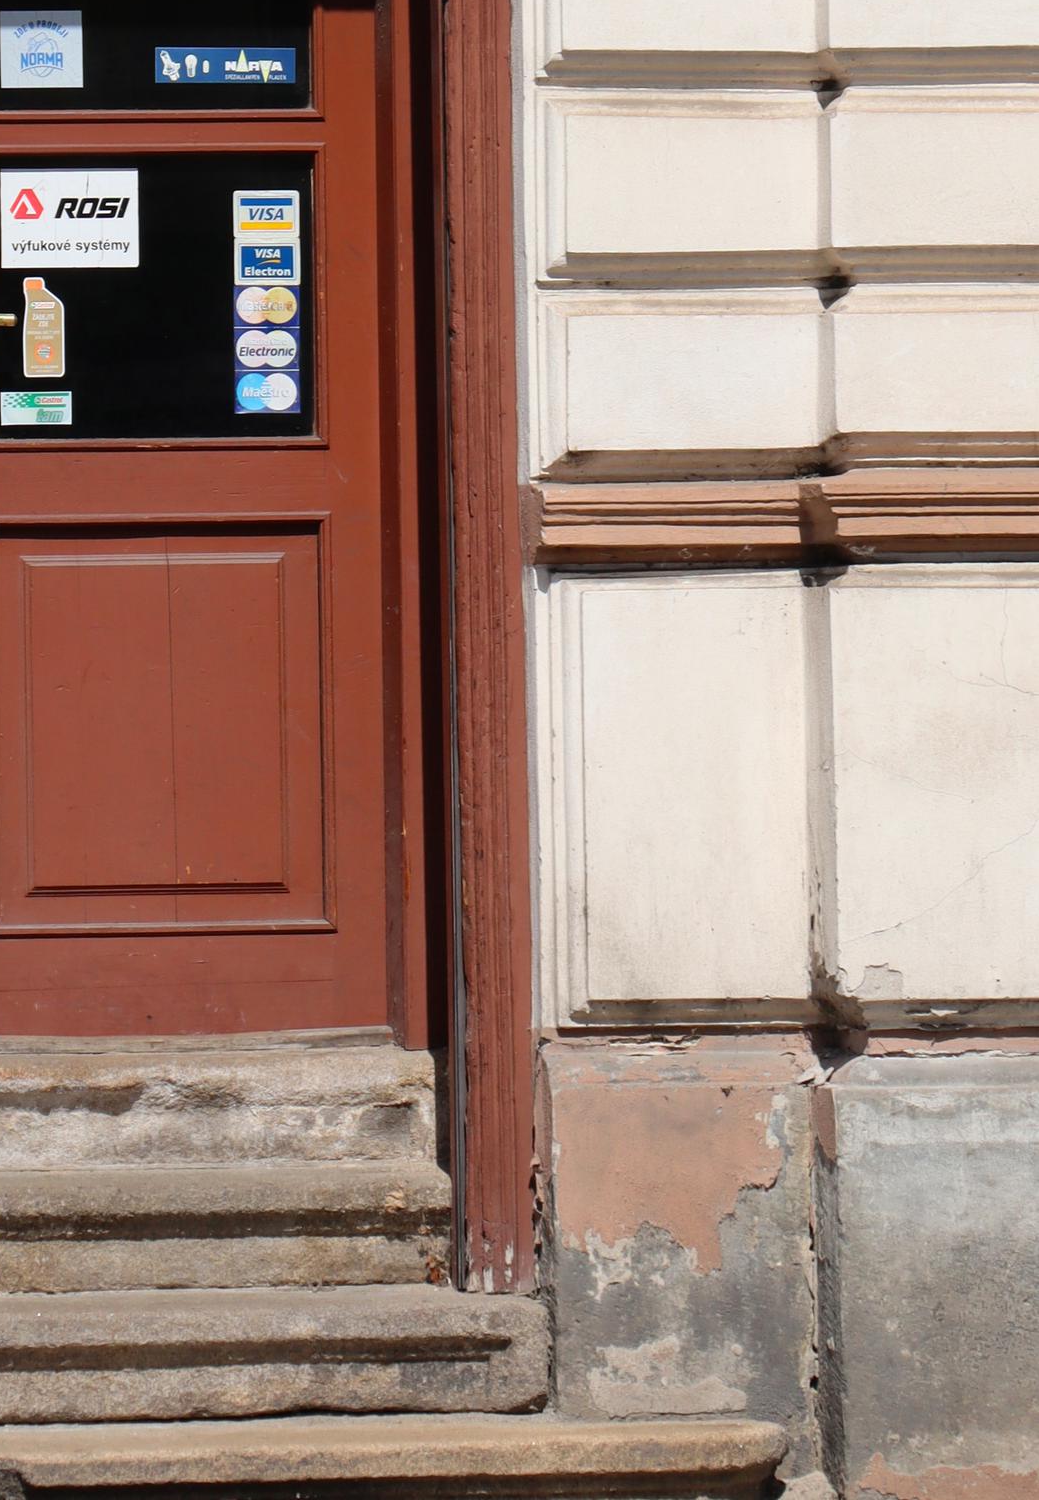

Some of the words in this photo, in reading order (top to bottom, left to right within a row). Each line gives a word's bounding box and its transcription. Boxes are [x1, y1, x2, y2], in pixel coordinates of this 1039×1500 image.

[20, 52, 64, 69] NORMA
[54, 197, 130, 219] ROSI
[248, 208, 284, 220] VISA
[12, 239, 71, 254] výfukové
[75, 239, 130, 254] systémy
[254, 248, 281, 259] VISA
[244, 266, 291, 276] Electron
[239, 346, 295, 357] Electronic
